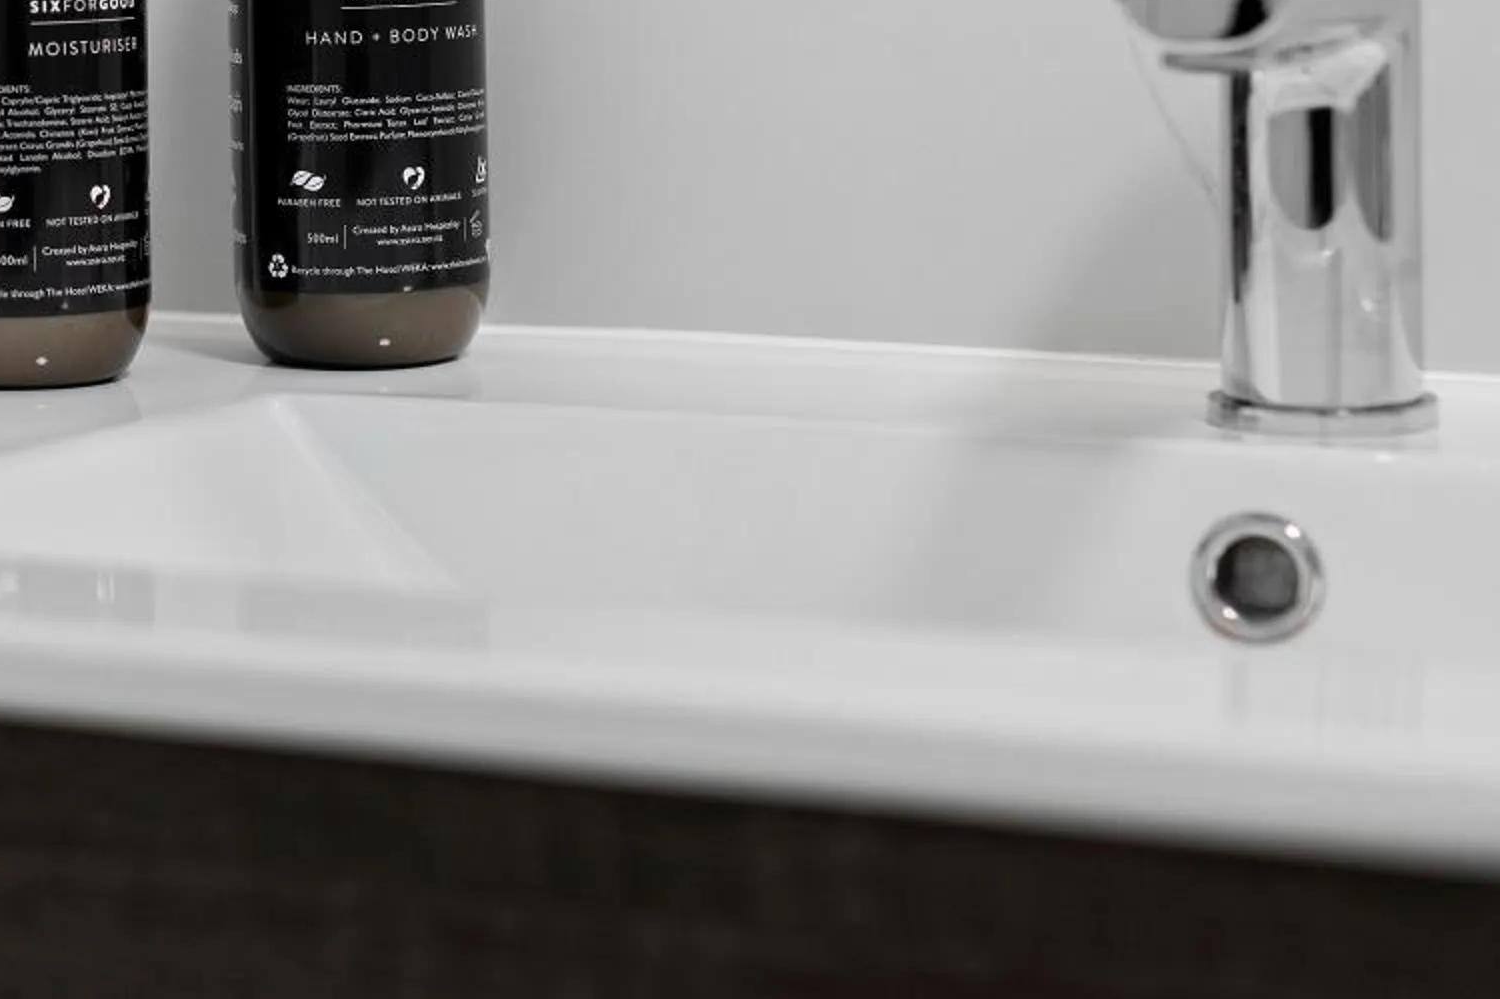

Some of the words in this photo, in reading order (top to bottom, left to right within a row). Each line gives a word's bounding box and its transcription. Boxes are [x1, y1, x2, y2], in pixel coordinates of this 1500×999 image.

[305, 30, 363, 45] HAND
[390, 27, 439, 44] BODY
[445, 24, 477, 40] WASH
[28, 36, 137, 56] MOISTURISER
[318, 199, 341, 207] FREE
[356, 198, 377, 207] NOT
[380, 196, 412, 206] TESTED
[414, 196, 427, 204] ON
[7, 219, 31, 228] FREE
[46, 218, 66, 227] NOT
[68, 215, 99, 226] TESTED
[307, 233, 339, 245] 500ml
